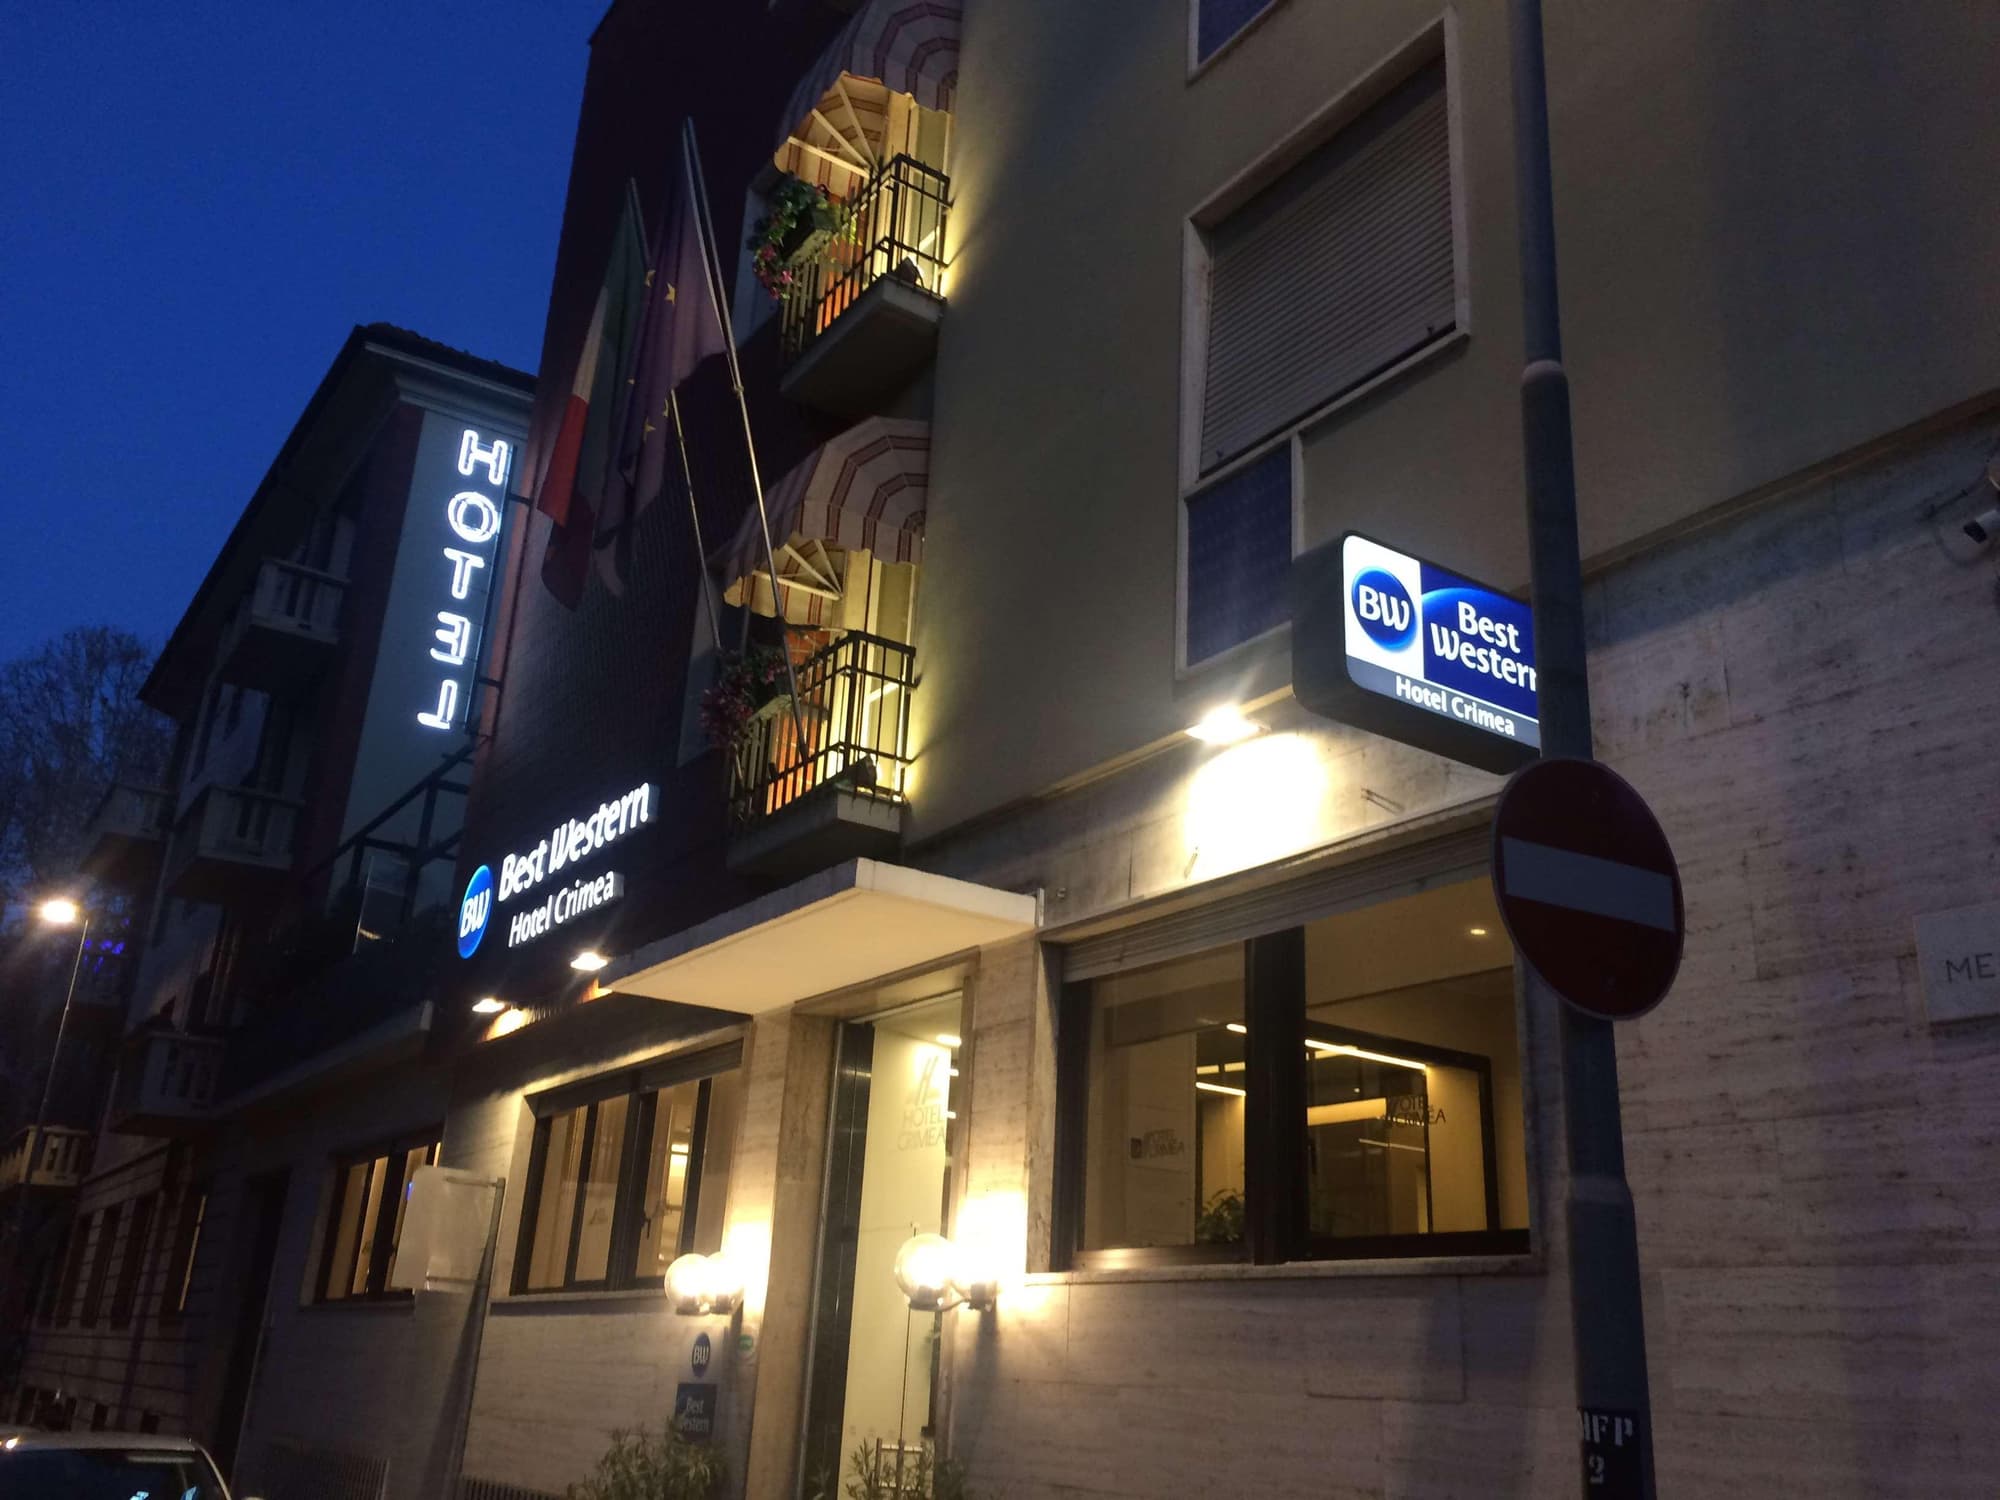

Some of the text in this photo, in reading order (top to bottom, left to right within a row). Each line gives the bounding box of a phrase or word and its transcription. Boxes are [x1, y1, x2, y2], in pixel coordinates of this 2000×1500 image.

[1358, 584, 1410, 631] BW
[1458, 601, 1521, 653] Best
[1396, 675, 1515, 736] Hotel Crimea
[499, 782, 650, 902] Best Western
[460, 887, 491, 938] BW
[509, 871, 614, 948] Hotel Crimea
[693, 1345, 710, 1365] BW
